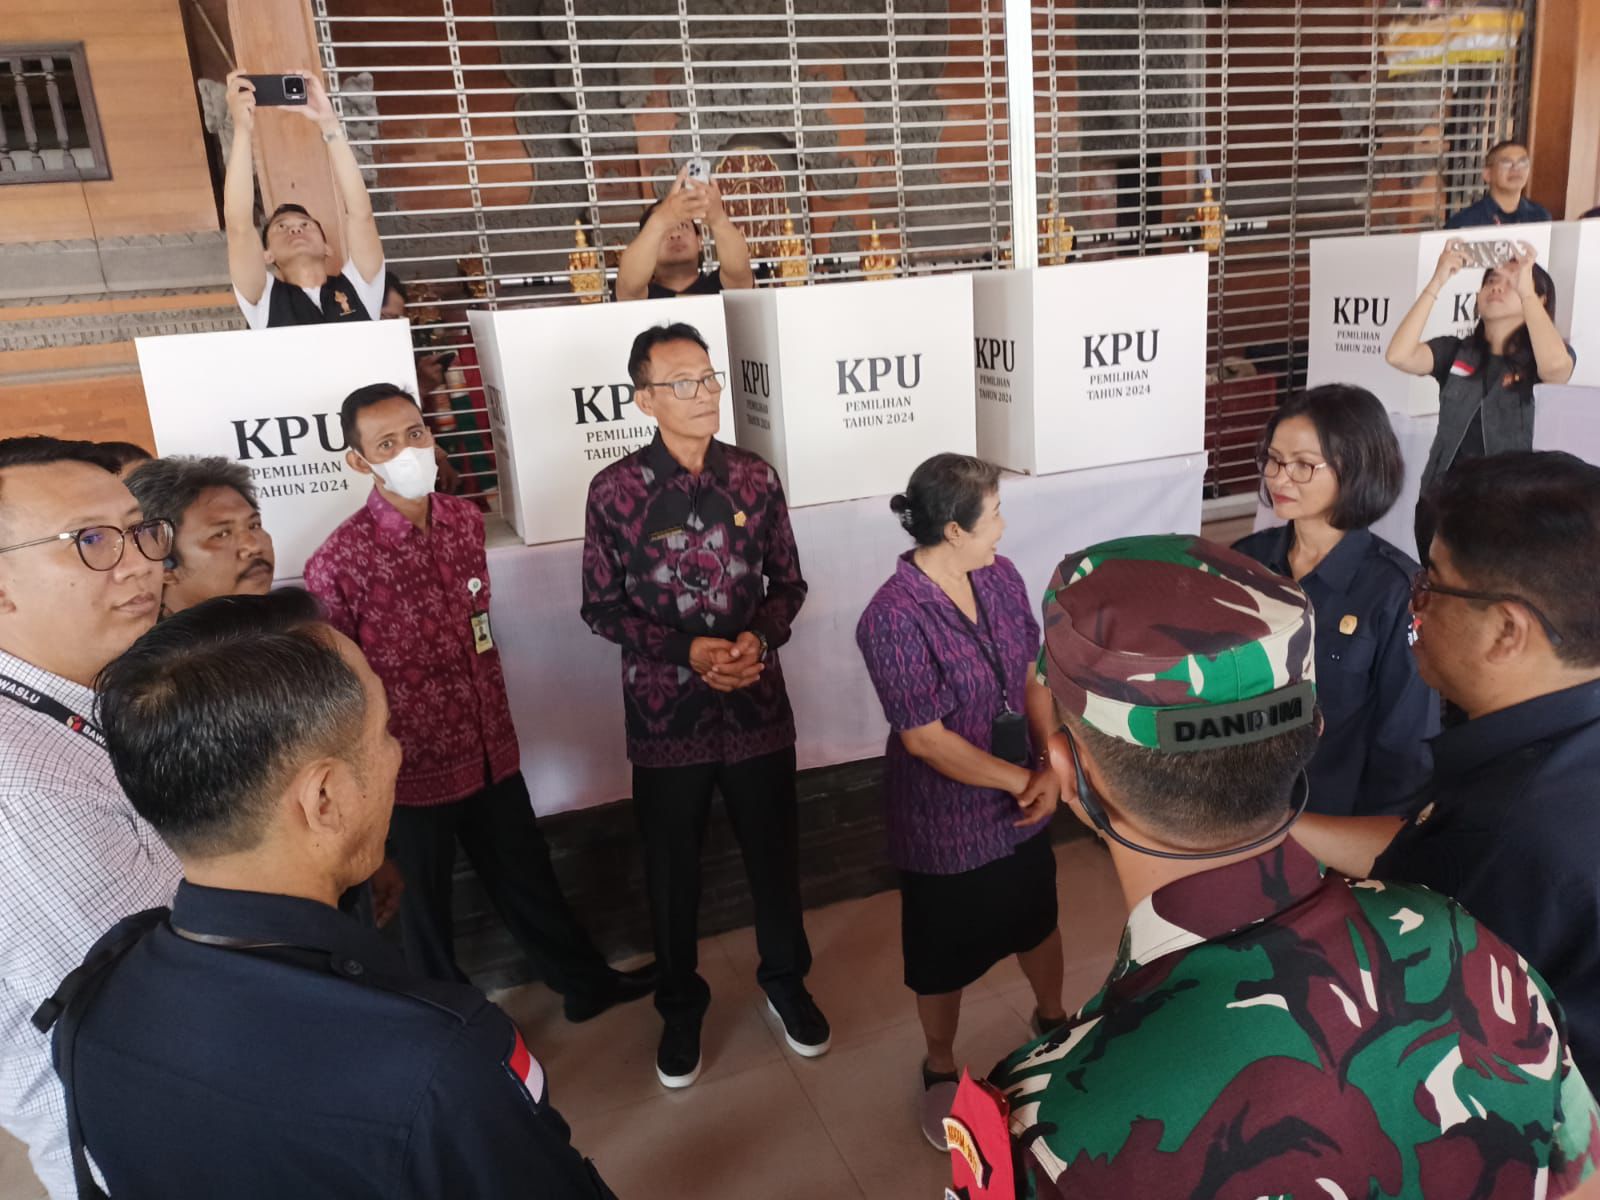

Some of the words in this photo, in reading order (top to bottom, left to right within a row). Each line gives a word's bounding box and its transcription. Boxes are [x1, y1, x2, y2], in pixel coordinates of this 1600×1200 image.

[1333, 297, 1390, 325] KPU
[1336, 330, 1380, 341] PEMILIHAN
[975, 337, 1015, 372] KPU
[1083, 329, 1159, 368] KPU
[1335, 343, 1360, 353] TAHUN
[1362, 343, 1381, 355] 2024
[741, 360, 770, 398] KPU
[836, 353, 922, 395] KPU
[1090, 369, 1149, 384] PEMILIHAN
[1087, 387, 1123, 400] TAHUN
[1125, 384, 1151, 396] 2024
[571, 383, 634, 425] KP
[846, 396, 912, 412] PEMILIHAN
[843, 413, 883, 429] TAHUN
[886, 411, 915, 424] 2024
[231, 411, 350, 461] KPU
[584, 445, 631, 461] TAHUN
[252, 461, 342, 480] PEMILIHAN
[310, 479, 349, 494] 2024
[1174, 697, 1302, 742] DANDIM
[82, 725, 107, 747] BAW
